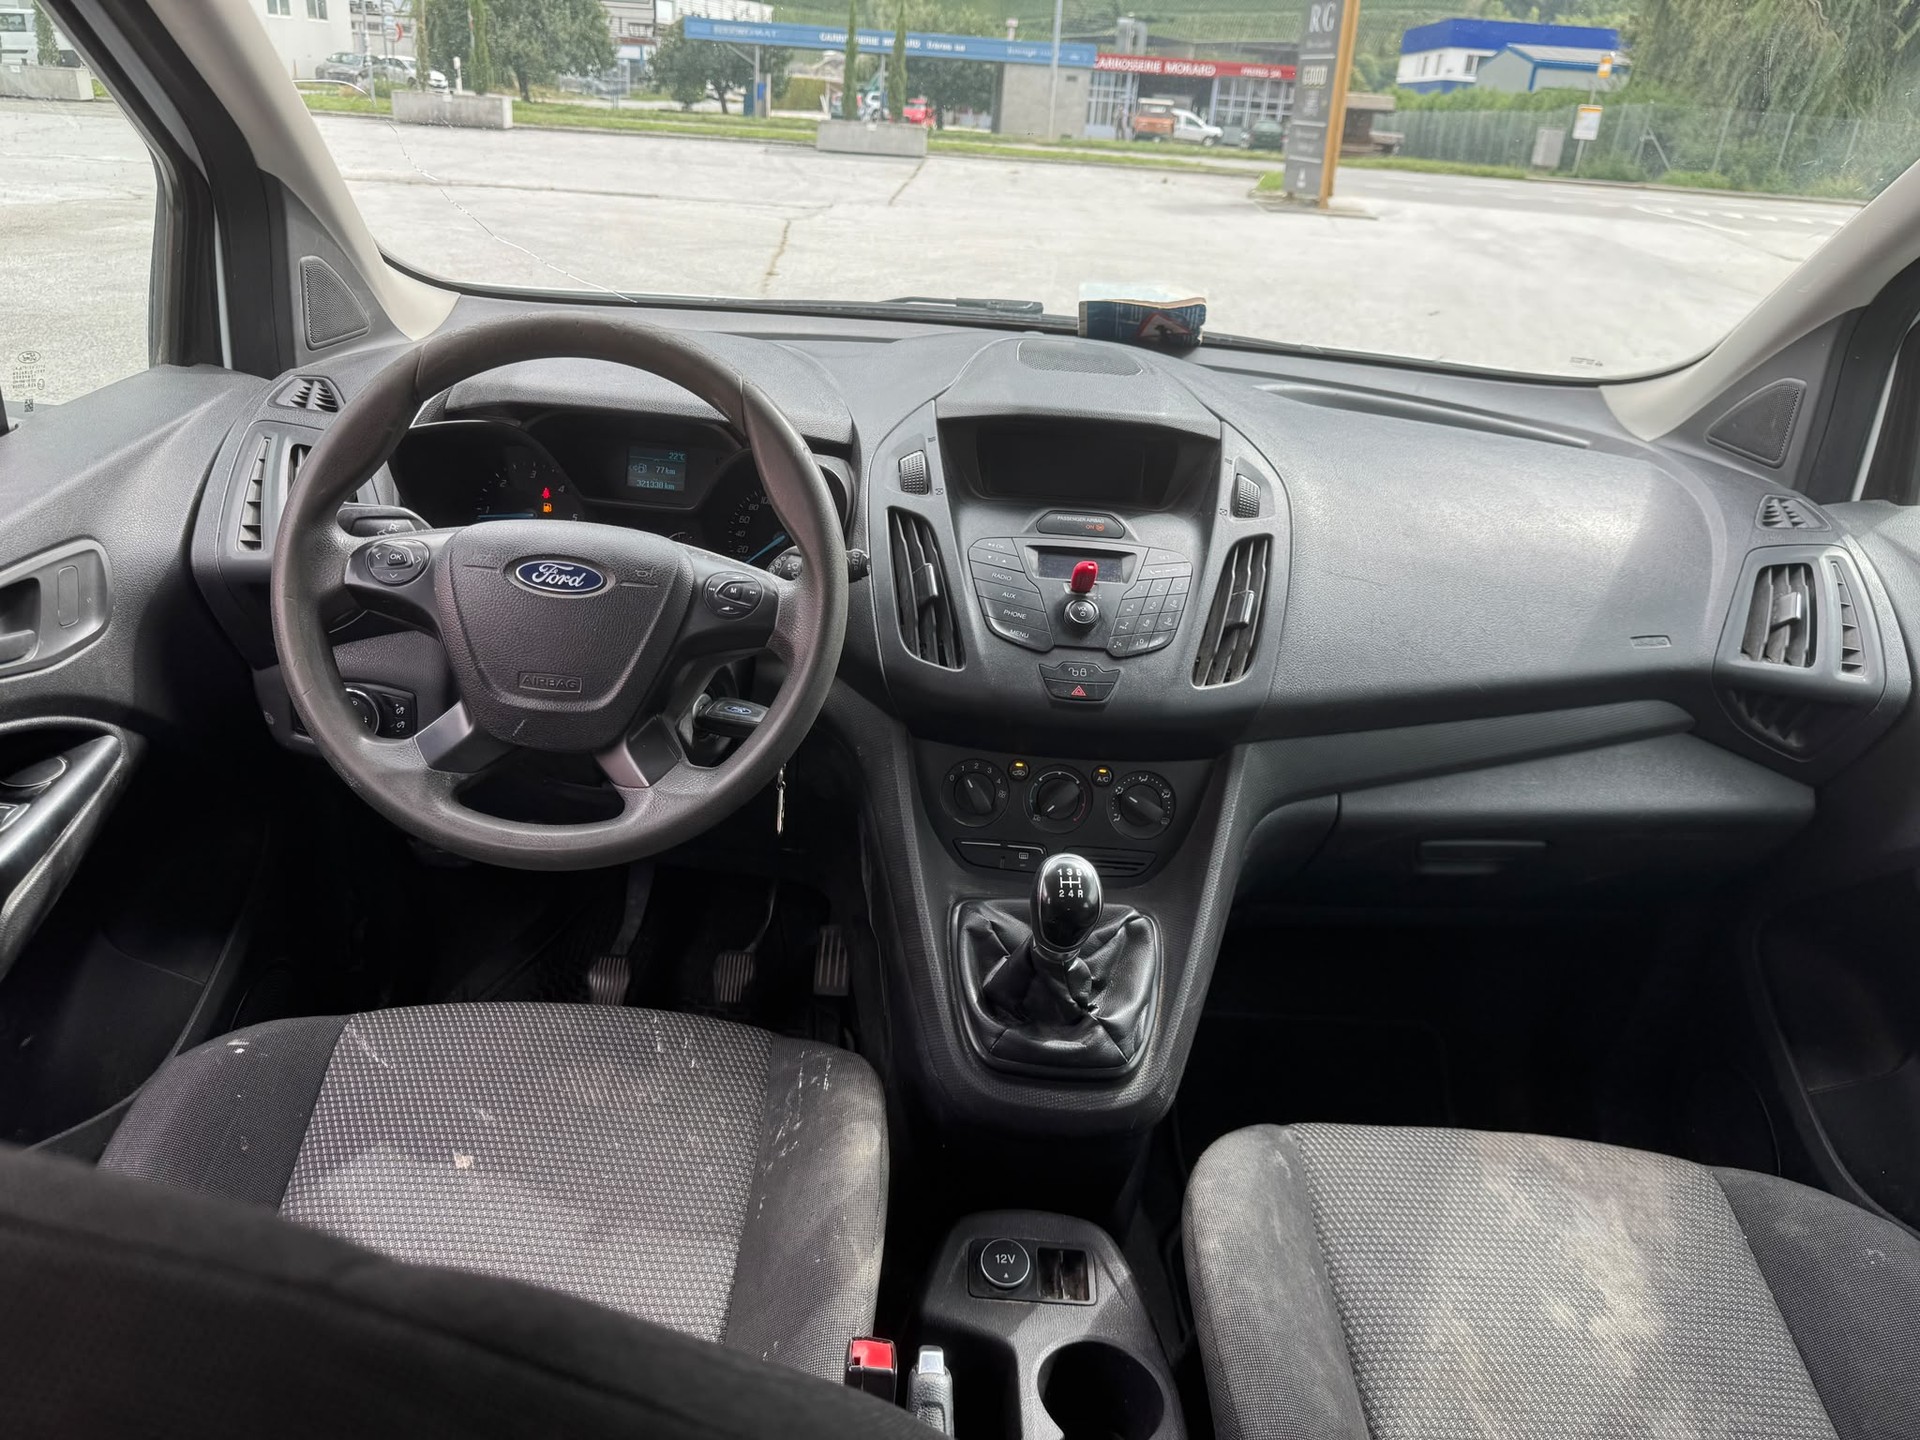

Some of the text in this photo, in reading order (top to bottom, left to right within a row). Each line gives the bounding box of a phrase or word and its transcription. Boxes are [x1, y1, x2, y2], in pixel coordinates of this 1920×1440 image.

[389, 553, 403, 561] OK
[532, 563, 587, 588] Ford
[991, 572, 1013, 581] RADIO
[1002, 591, 1017, 599] AUX
[1003, 609, 1027, 620] PHONE
[1010, 628, 1030, 639] MENU
[521, 674, 577, 689] AIRBAG
[995, 1253, 1016, 1265] 12V
